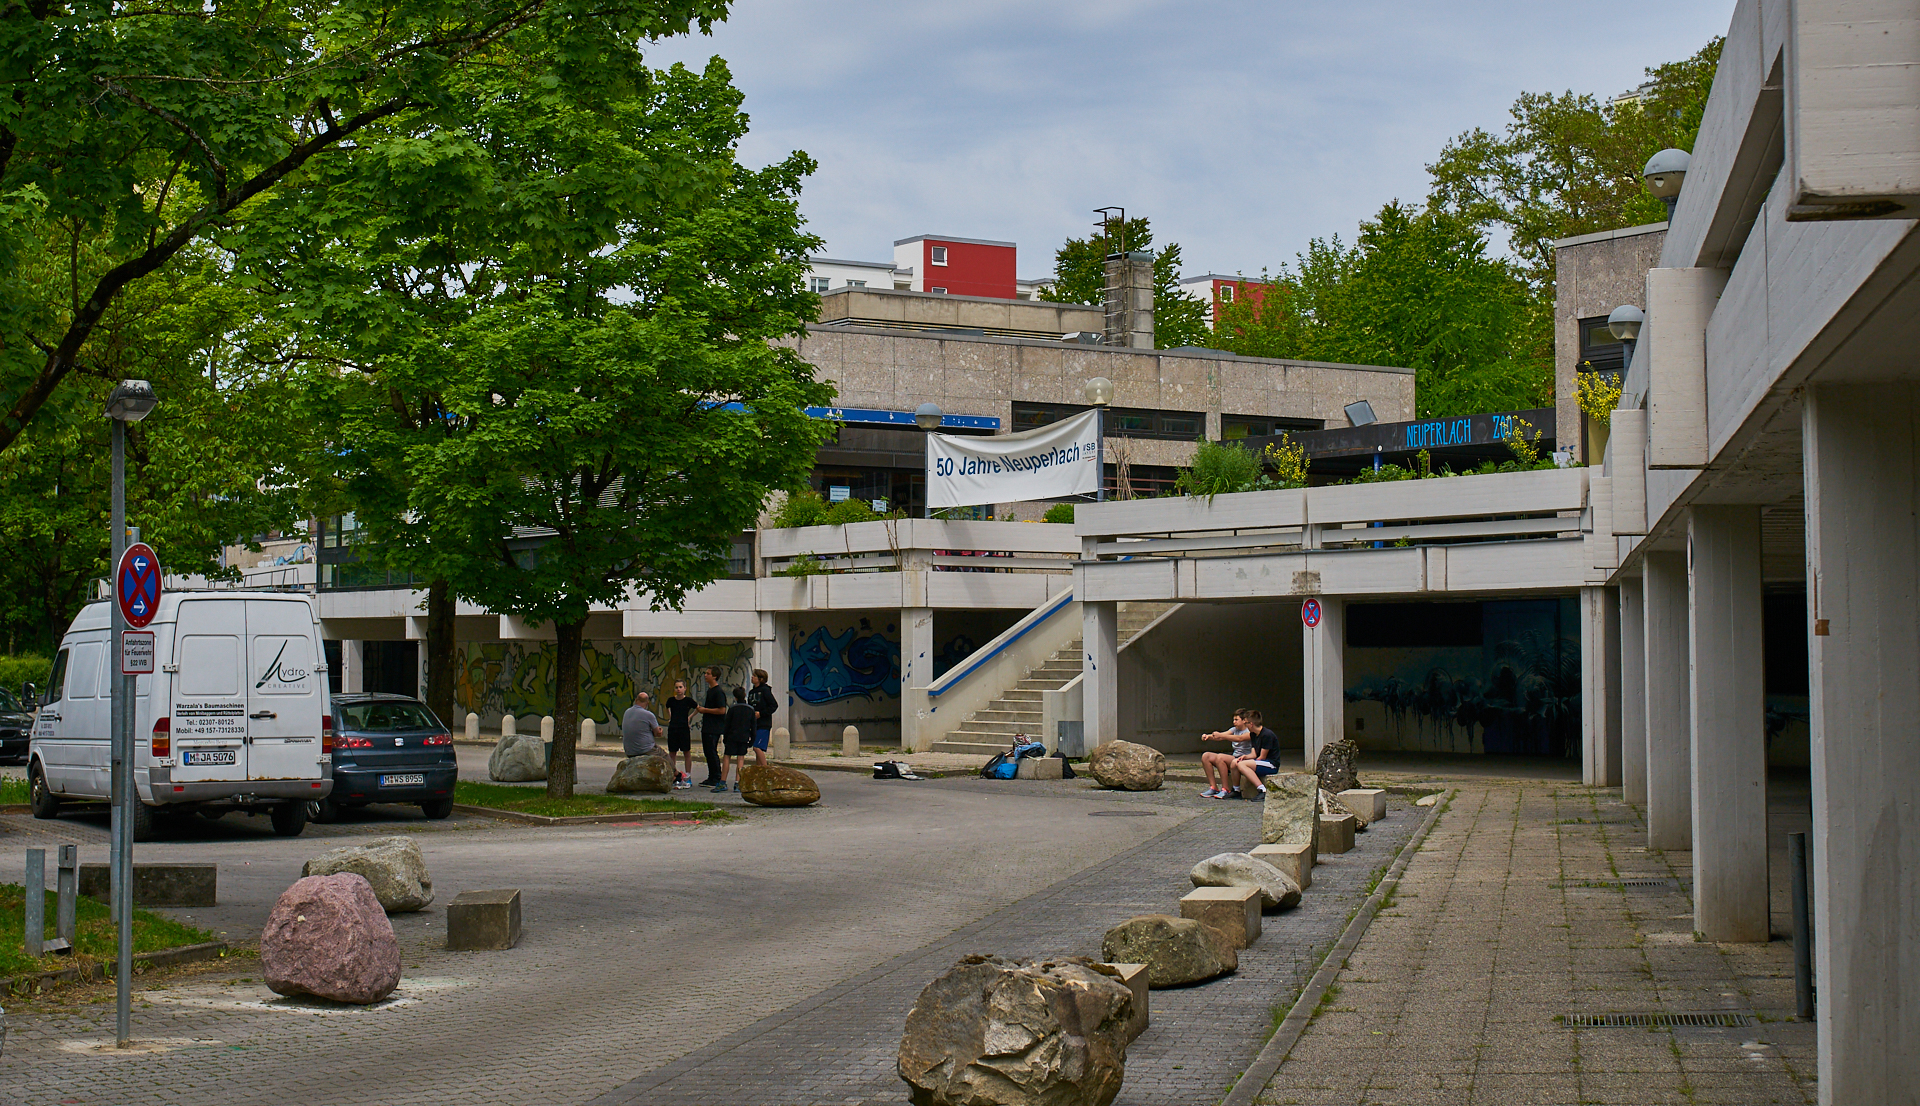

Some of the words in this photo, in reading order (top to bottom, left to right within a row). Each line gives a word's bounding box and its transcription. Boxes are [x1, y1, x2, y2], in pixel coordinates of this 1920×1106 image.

[1406, 419, 1471, 448] NEUPERLACH
[1493, 415, 1513, 439] ZOO
[936, 457, 954, 477] 50
[959, 456, 1001, 476] Jahre
[999, 442, 1080, 474] Neuperlach
[198, 718, 235, 726] 02307-80125
[206, 726, 245, 734] 157-73128330
[189, 752, 196, 762] M
[200, 752, 212, 762] JA
[212, 752, 234, 762] 5076
[384, 775, 390, 784] M
[394, 775, 404, 783] WS
[405, 774, 423, 783] 8955
